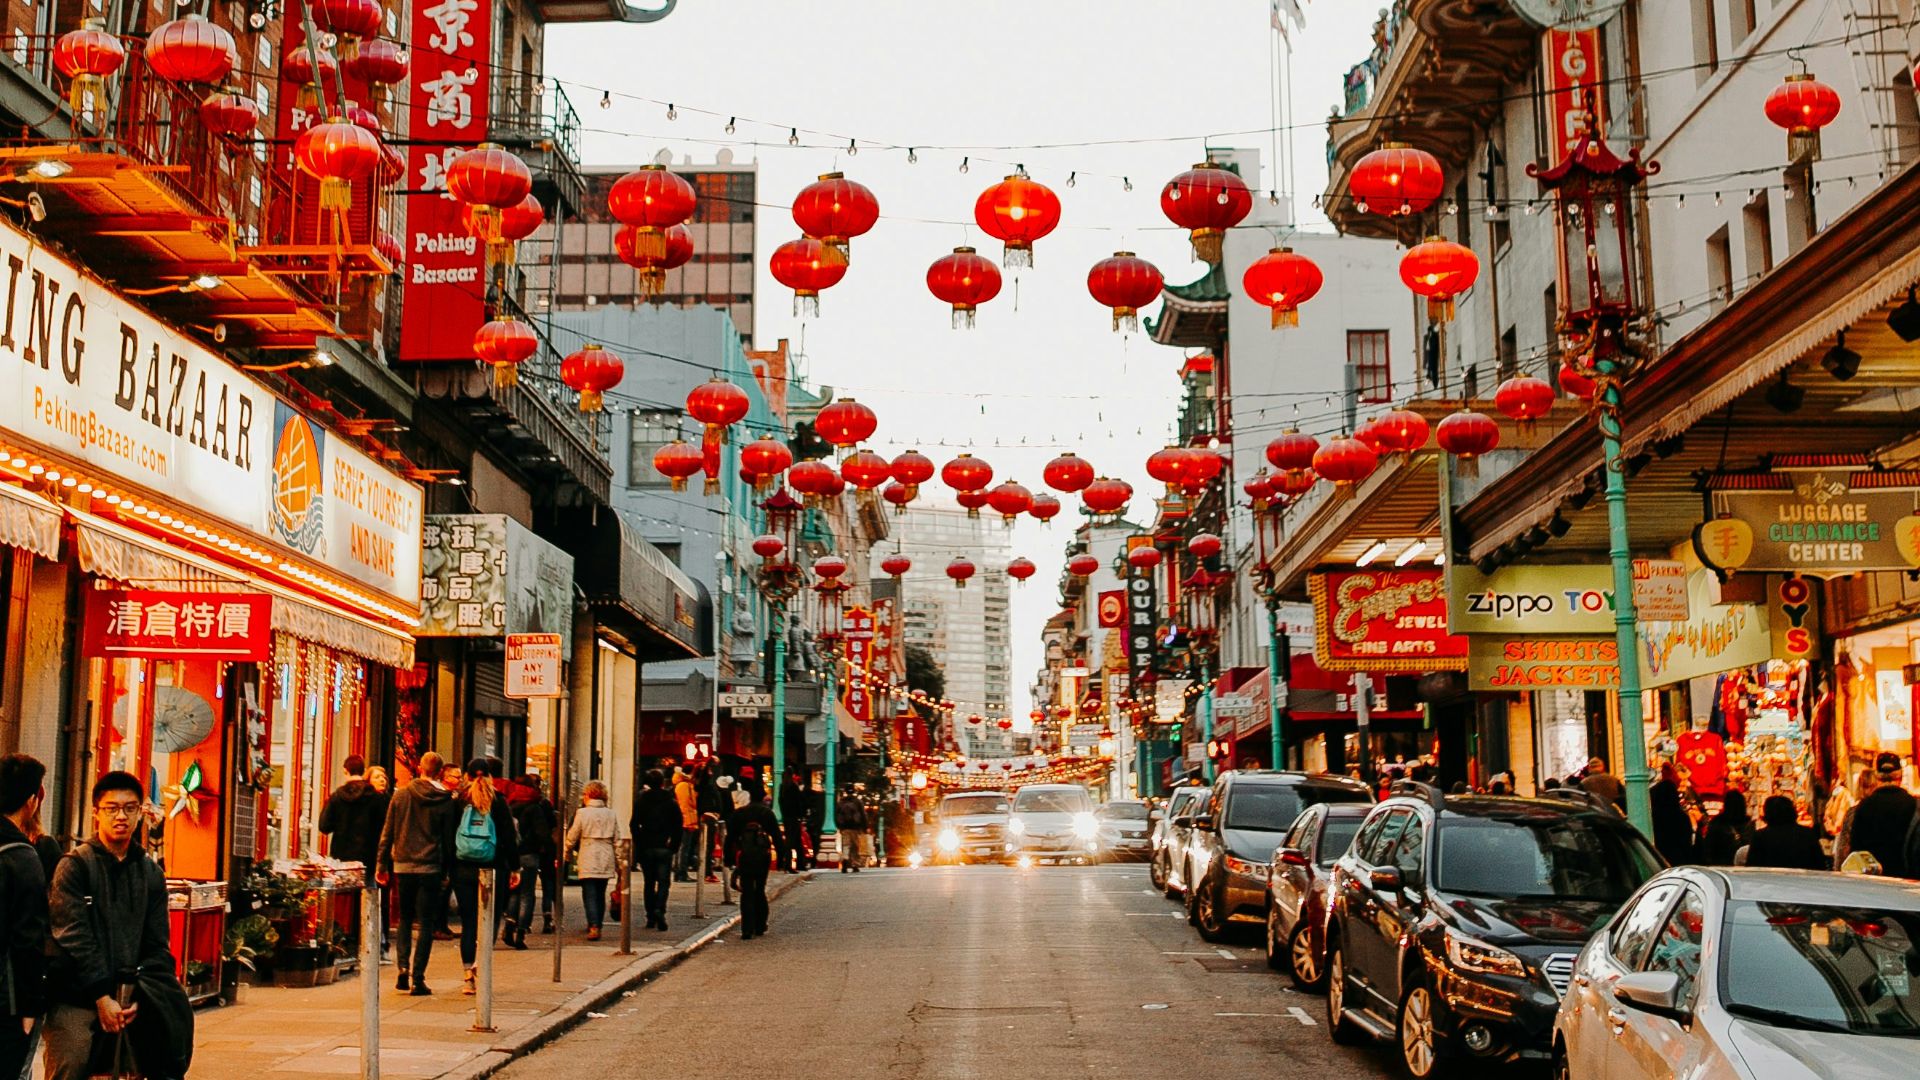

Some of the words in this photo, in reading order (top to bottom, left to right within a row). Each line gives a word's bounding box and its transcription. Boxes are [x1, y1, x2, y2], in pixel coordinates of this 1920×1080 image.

[415, 232, 477, 256] Peking
[412, 263, 478, 285] Bazaar
[0, 253, 86, 388] ING
[115, 321, 254, 472] BAZAAR
[34, 386, 167, 477] PekingBazaar.com
[334, 457, 364, 510] SERVE
[367, 476, 414, 535] YOURSELF
[1779, 504, 1868, 521] LUGGAGE
[1769, 522, 1880, 542] CLEARANCE
[351, 522, 370, 566] AND
[372, 532, 394, 577] SAVE
[1789, 543, 1864, 562] CENTER
[1634, 561, 1648, 577] NO
[1650, 565, 1685, 577] PARKING
[106, 600, 250, 639] 清倉特價
[1780, 580, 1810, 654] OYS
[508, 645, 522, 660] NO
[523, 648, 558, 660] STOPPING
[1351, 641, 1388, 654] FINE
[1392, 640, 1436, 654] ARTS
[1504, 641, 1619, 662] SHIRTS
[523, 663, 544, 673] ANY
[521, 675, 544, 686] TIME
[724, 695, 767, 705] CLAY
